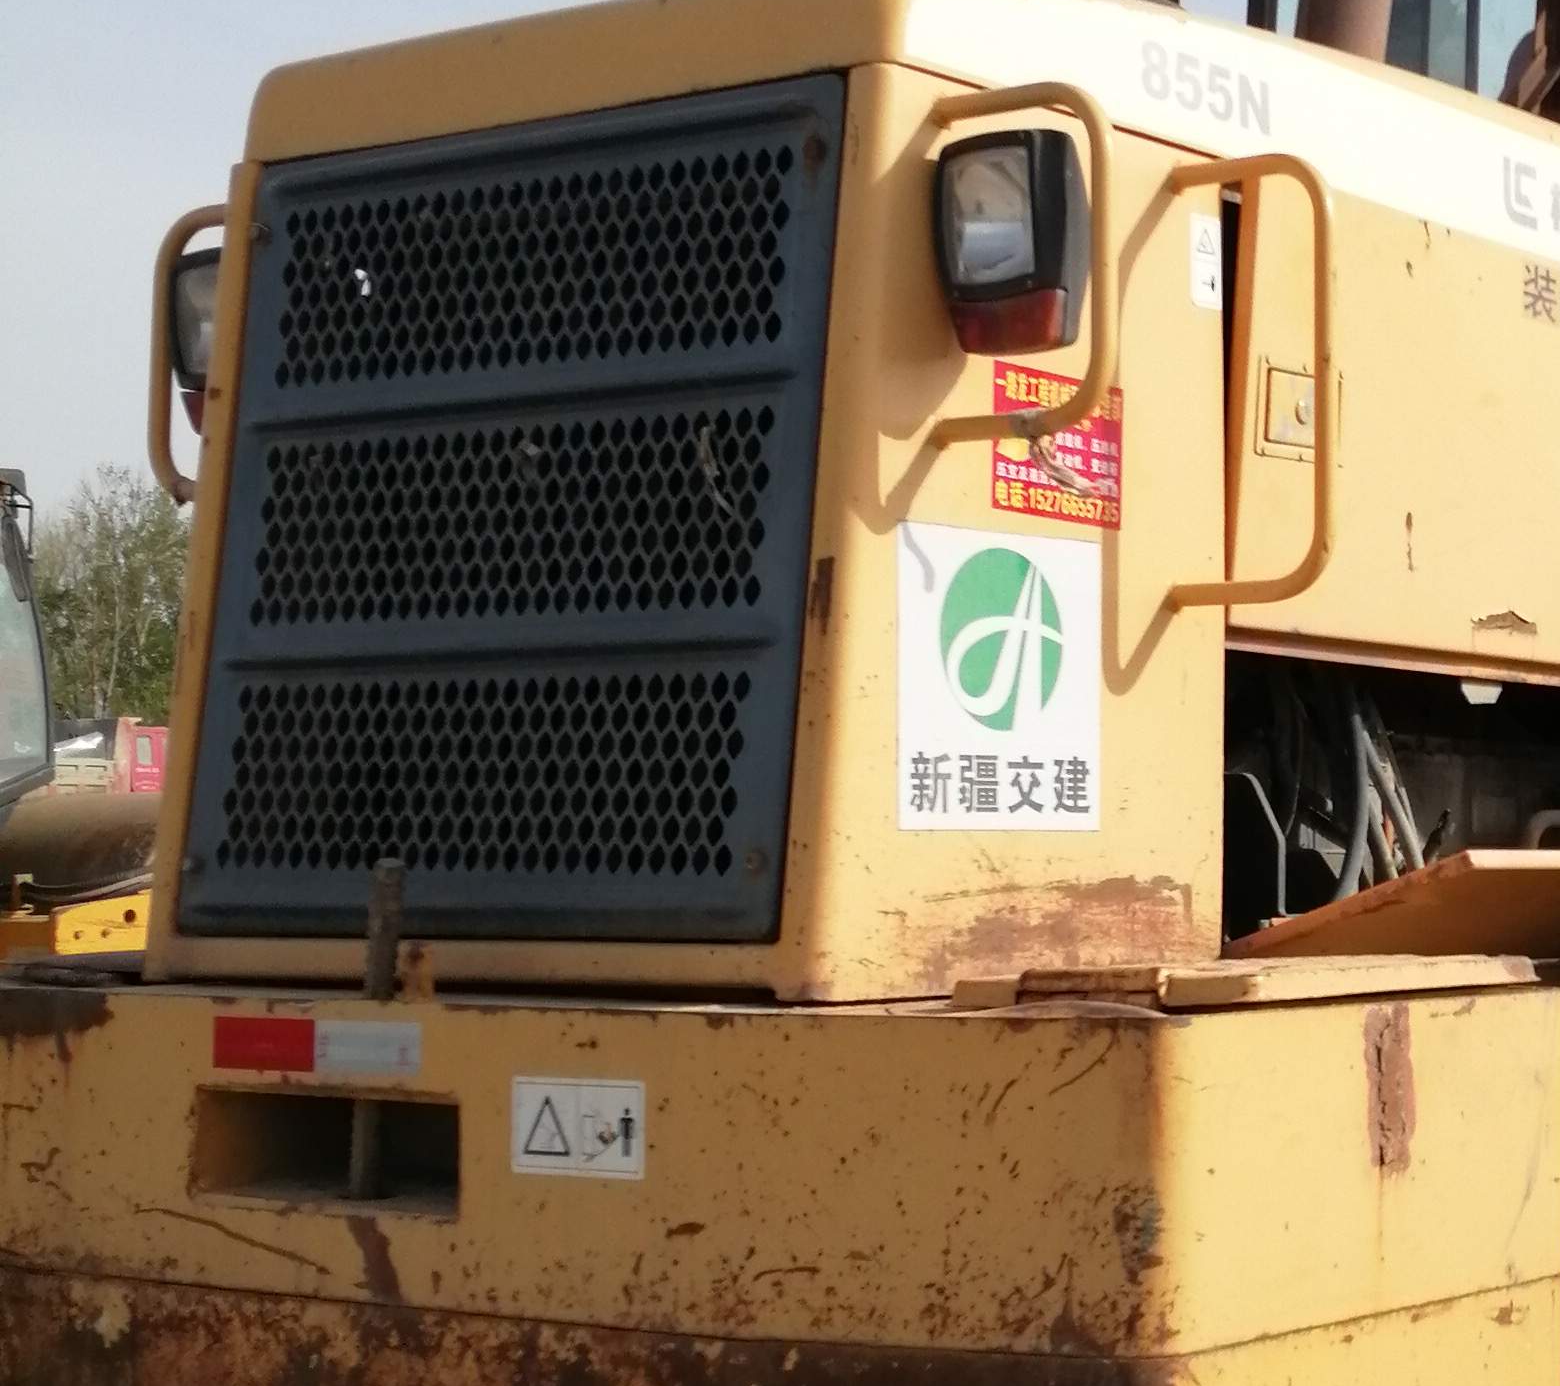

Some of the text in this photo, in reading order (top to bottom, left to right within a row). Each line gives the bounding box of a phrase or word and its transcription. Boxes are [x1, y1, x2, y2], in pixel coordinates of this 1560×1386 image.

[1141, 41, 1271, 136] 855N
[910, 749, 1091, 815] 新疆交建
